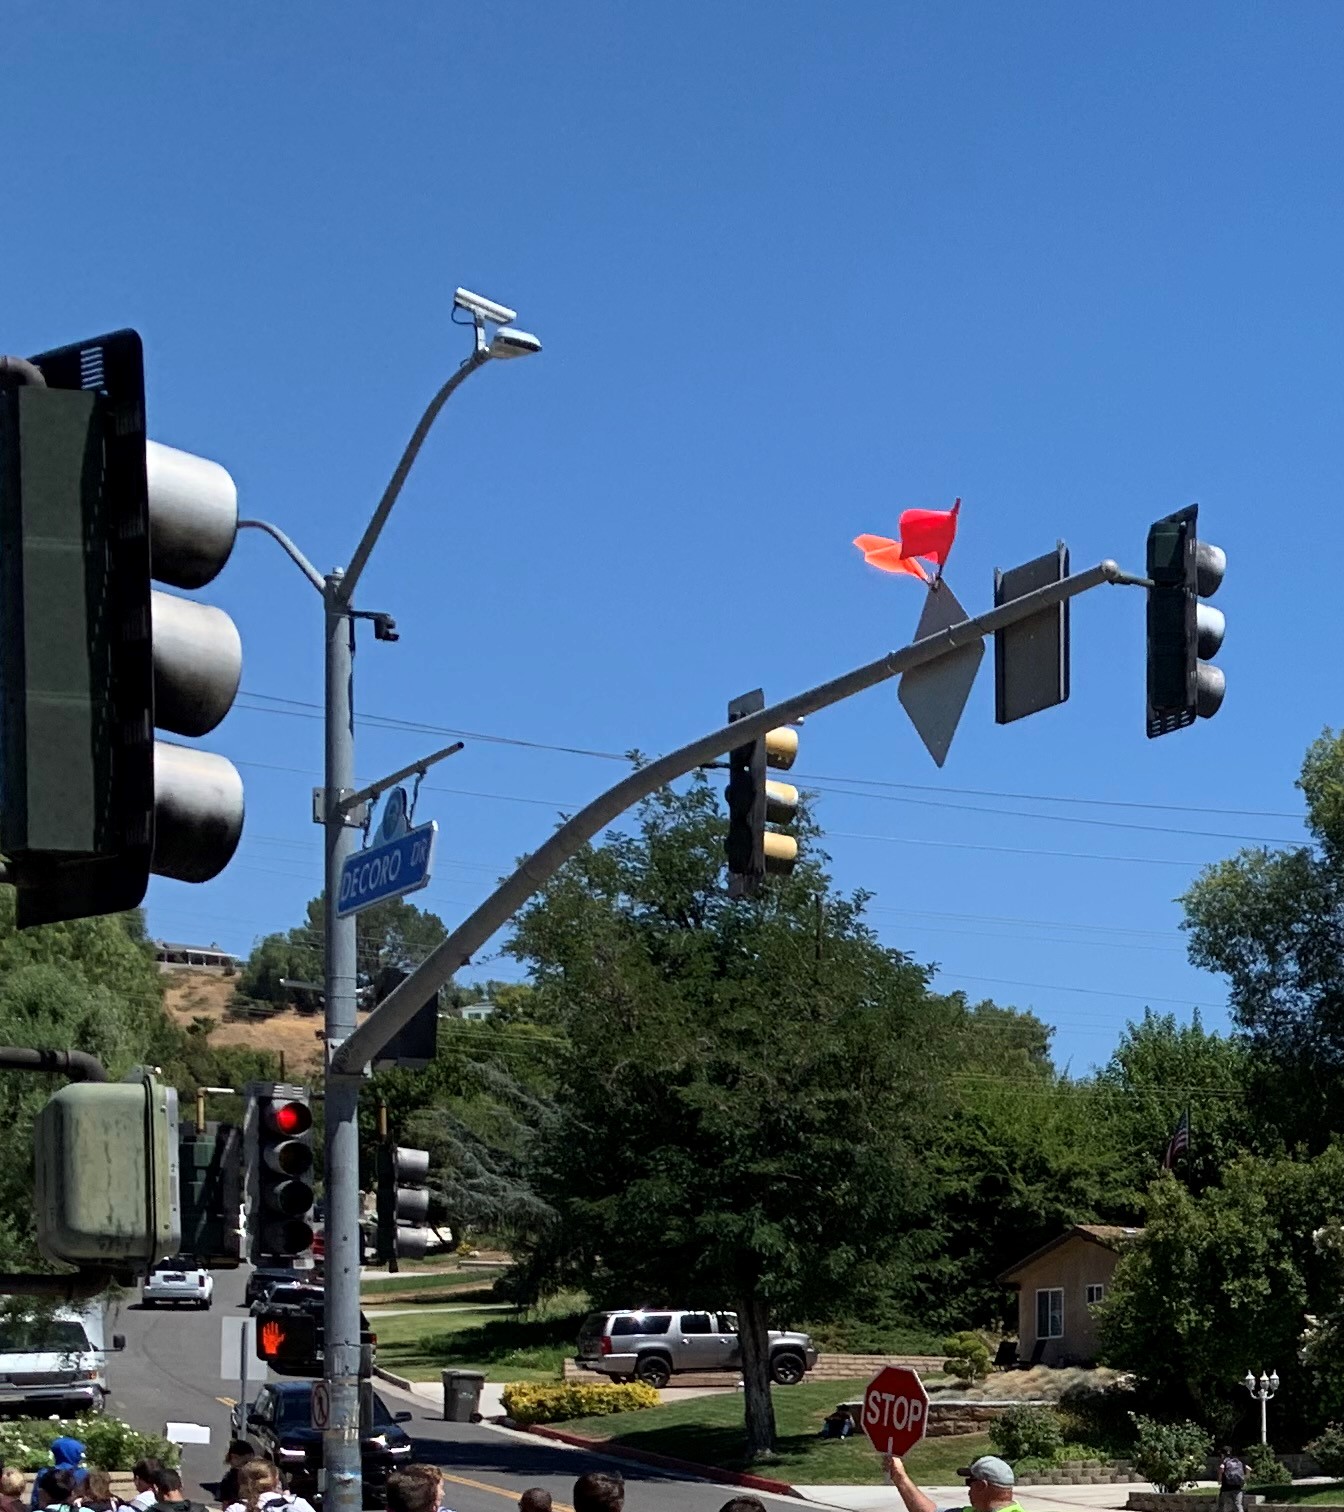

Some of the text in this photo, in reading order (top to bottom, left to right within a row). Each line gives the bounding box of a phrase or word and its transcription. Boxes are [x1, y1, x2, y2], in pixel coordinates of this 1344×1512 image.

[341, 839, 427, 902] DECORO DR
[866, 1390, 923, 1432] STOP
